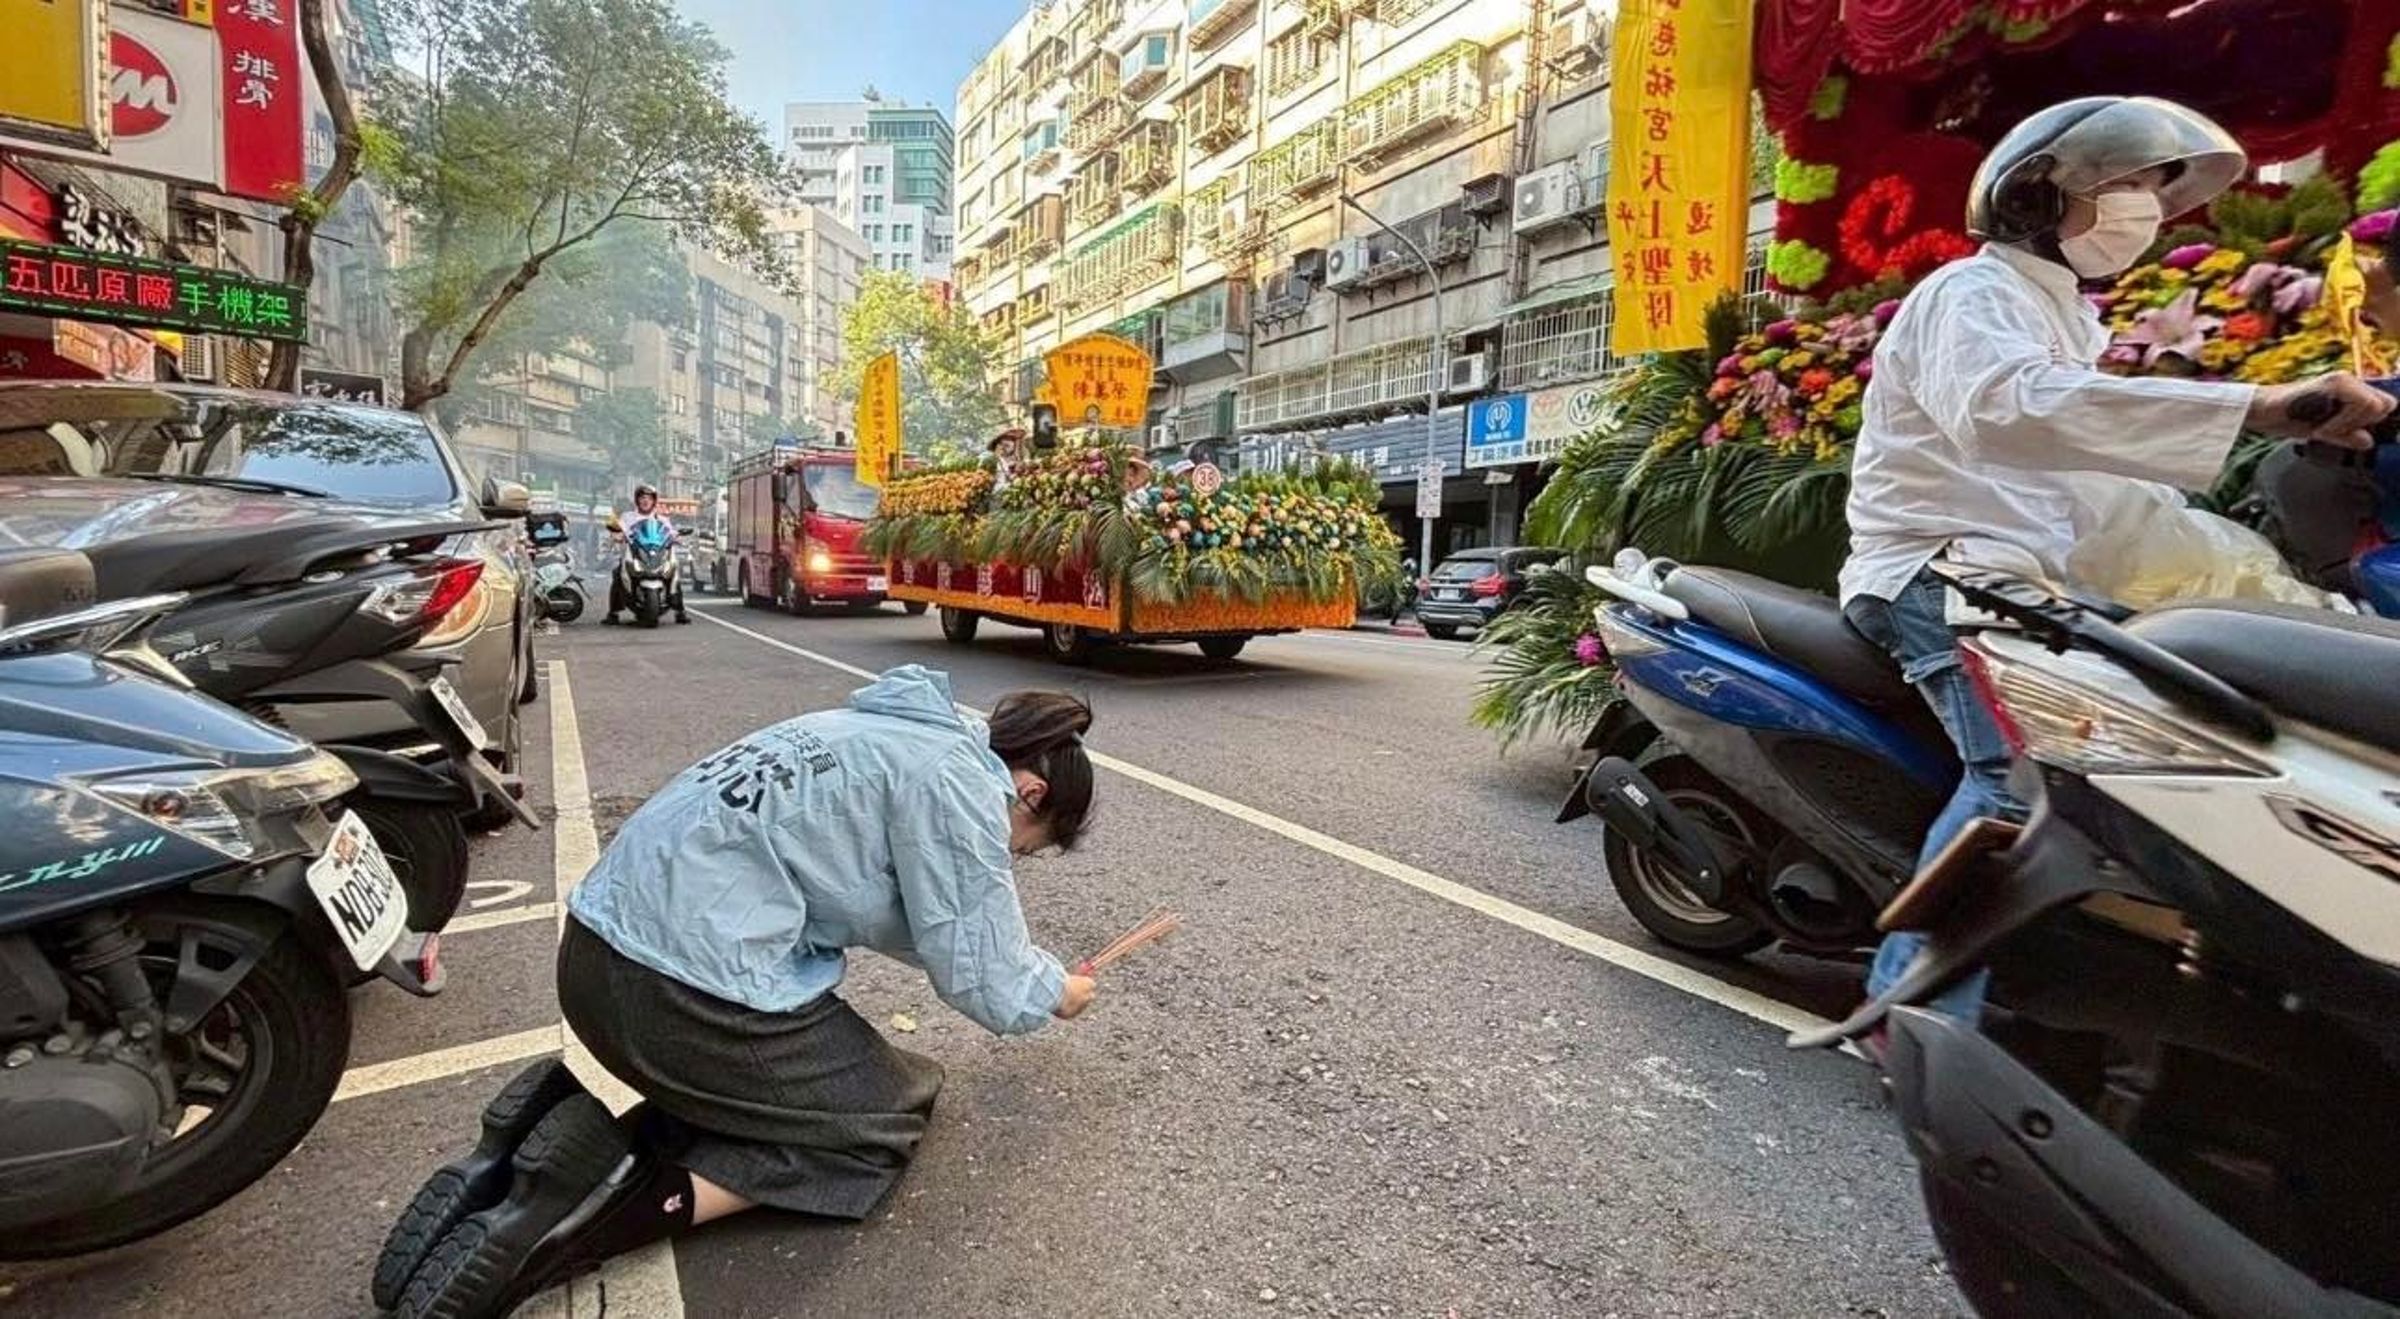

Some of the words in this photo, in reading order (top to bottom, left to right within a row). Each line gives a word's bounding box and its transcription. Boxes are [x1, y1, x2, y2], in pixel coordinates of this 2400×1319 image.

[1640, 0, 1681, 330] 慈祐宮天上聖母
[5, 254, 293, 329] 五匹原廠手機架
